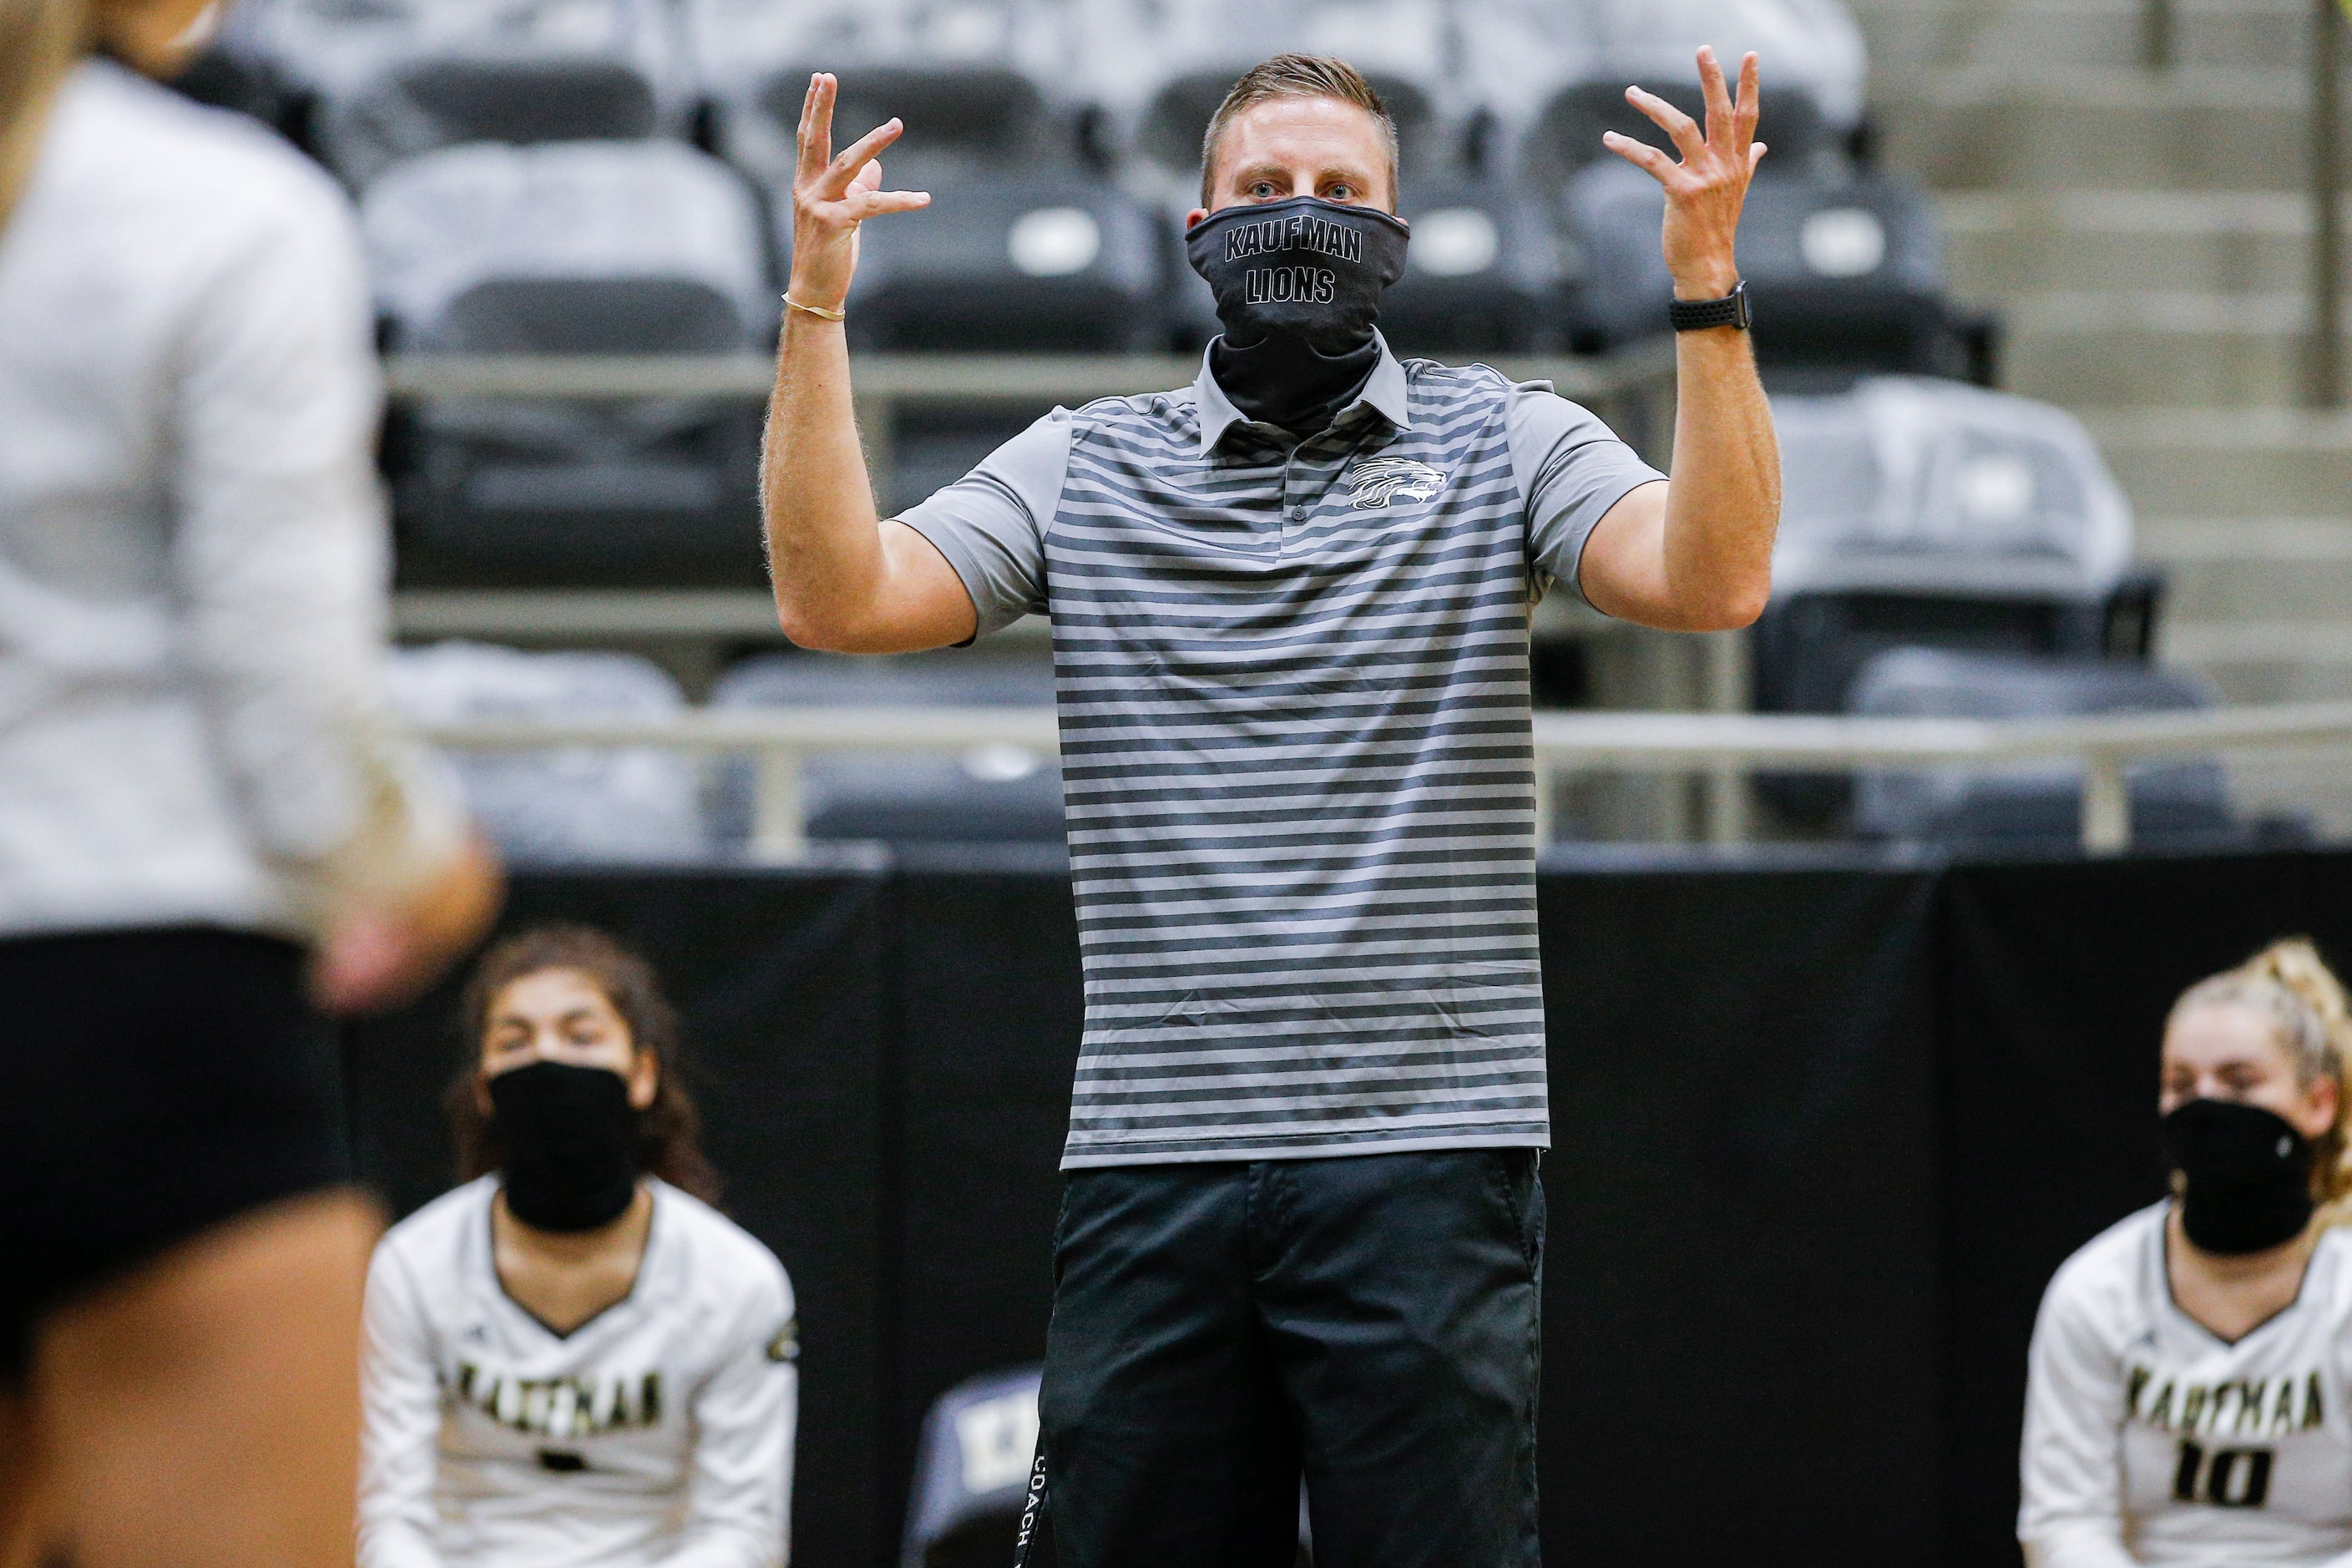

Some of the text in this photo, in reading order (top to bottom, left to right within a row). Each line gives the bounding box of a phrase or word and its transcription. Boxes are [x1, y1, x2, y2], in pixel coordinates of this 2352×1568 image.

[1225, 215, 1362, 264] KAUFMAN
[1246, 266, 1336, 304] LIONS
[1017, 1456, 1046, 1546] COACH
[2173, 1439, 2274, 1507] 10
